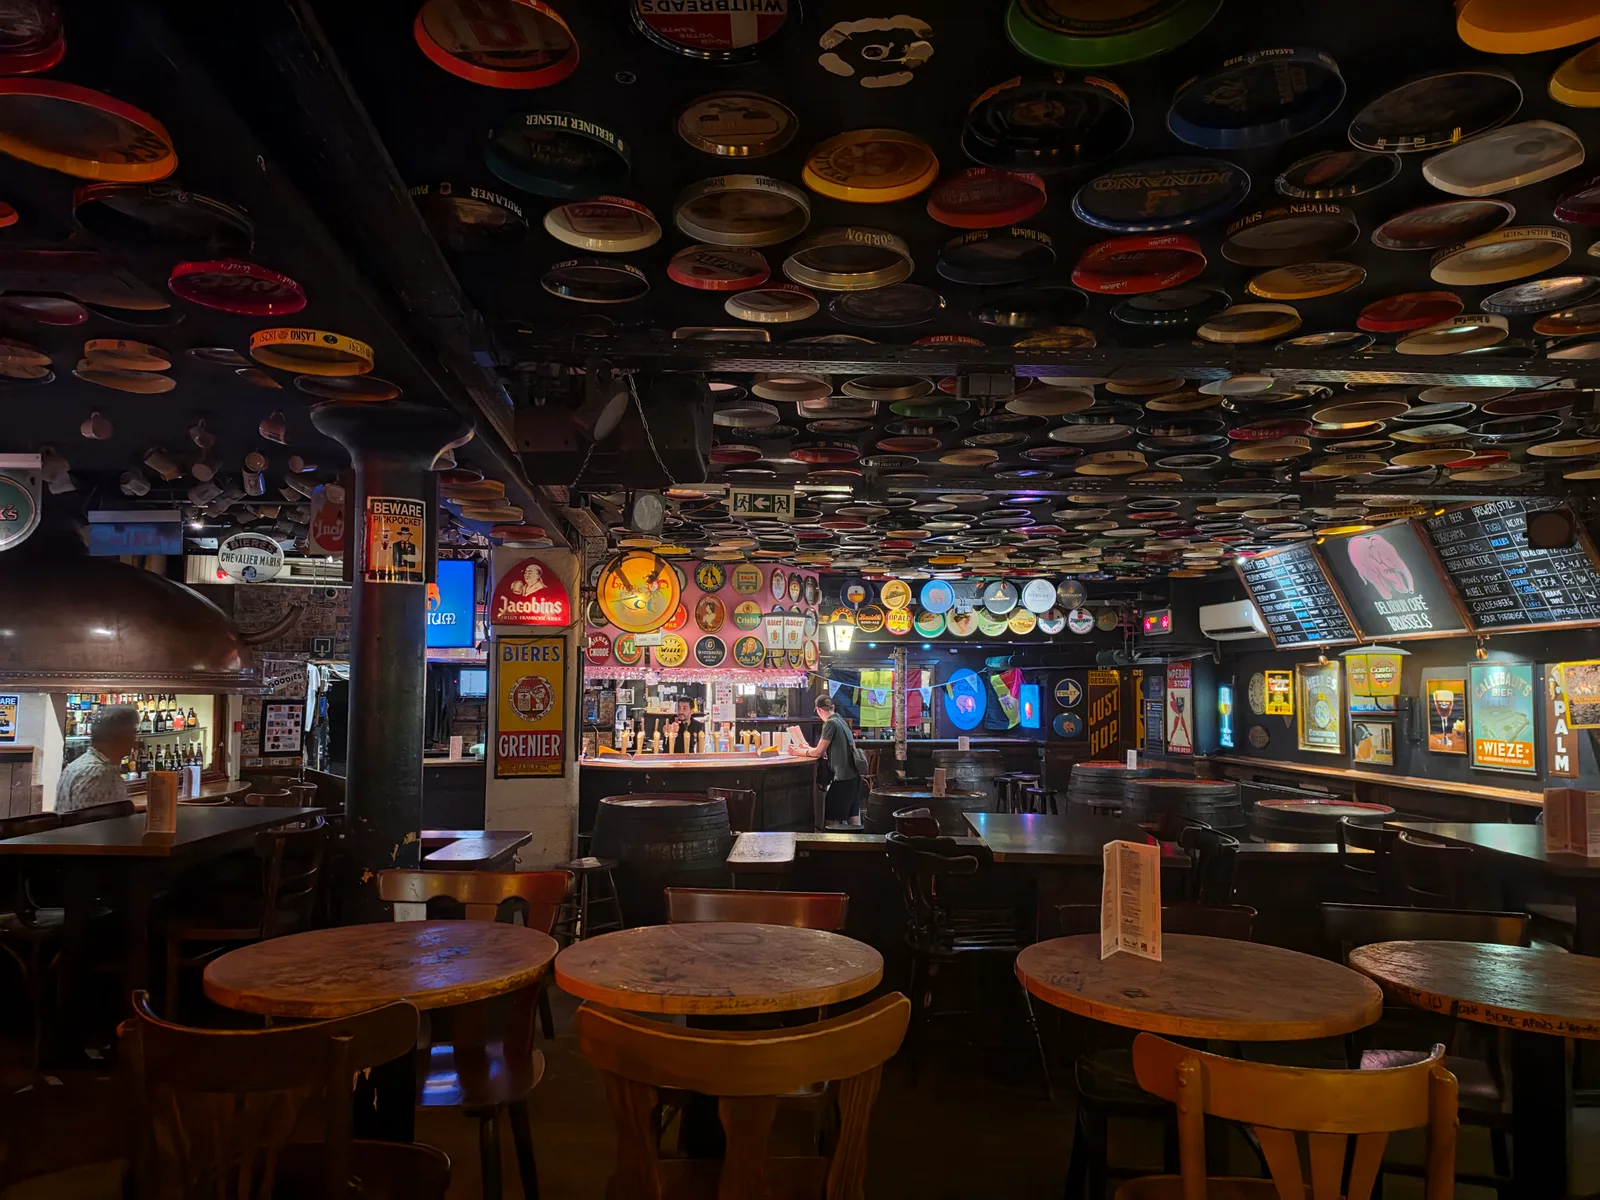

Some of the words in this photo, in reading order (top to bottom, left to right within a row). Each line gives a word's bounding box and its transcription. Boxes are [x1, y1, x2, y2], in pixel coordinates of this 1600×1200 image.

[525, 114, 568, 129] PILSNER
[570, 118, 615, 145] BERLINER
[470, 186, 523, 218] PAULANER
[844, 227, 894, 247] GORDON
[373, 502, 422, 518] BEWARE
[372, 515, 422, 527] PICKPOCKET
[220, 551, 259, 566] CHEVALIER
[1482, 572, 1503, 583] STOUT
[497, 595, 563, 618] Jacobins
[1386, 612, 1433, 632] BRUSSELS
[1173, 679, 1191, 689] STOUT
[1492, 688, 1514, 698] BIER
[1089, 687, 1119, 727] JUST
[1553, 700, 1570, 772] PALM
[499, 733, 561, 758] GRENIER
[1483, 741, 1524, 758] WIEZE
